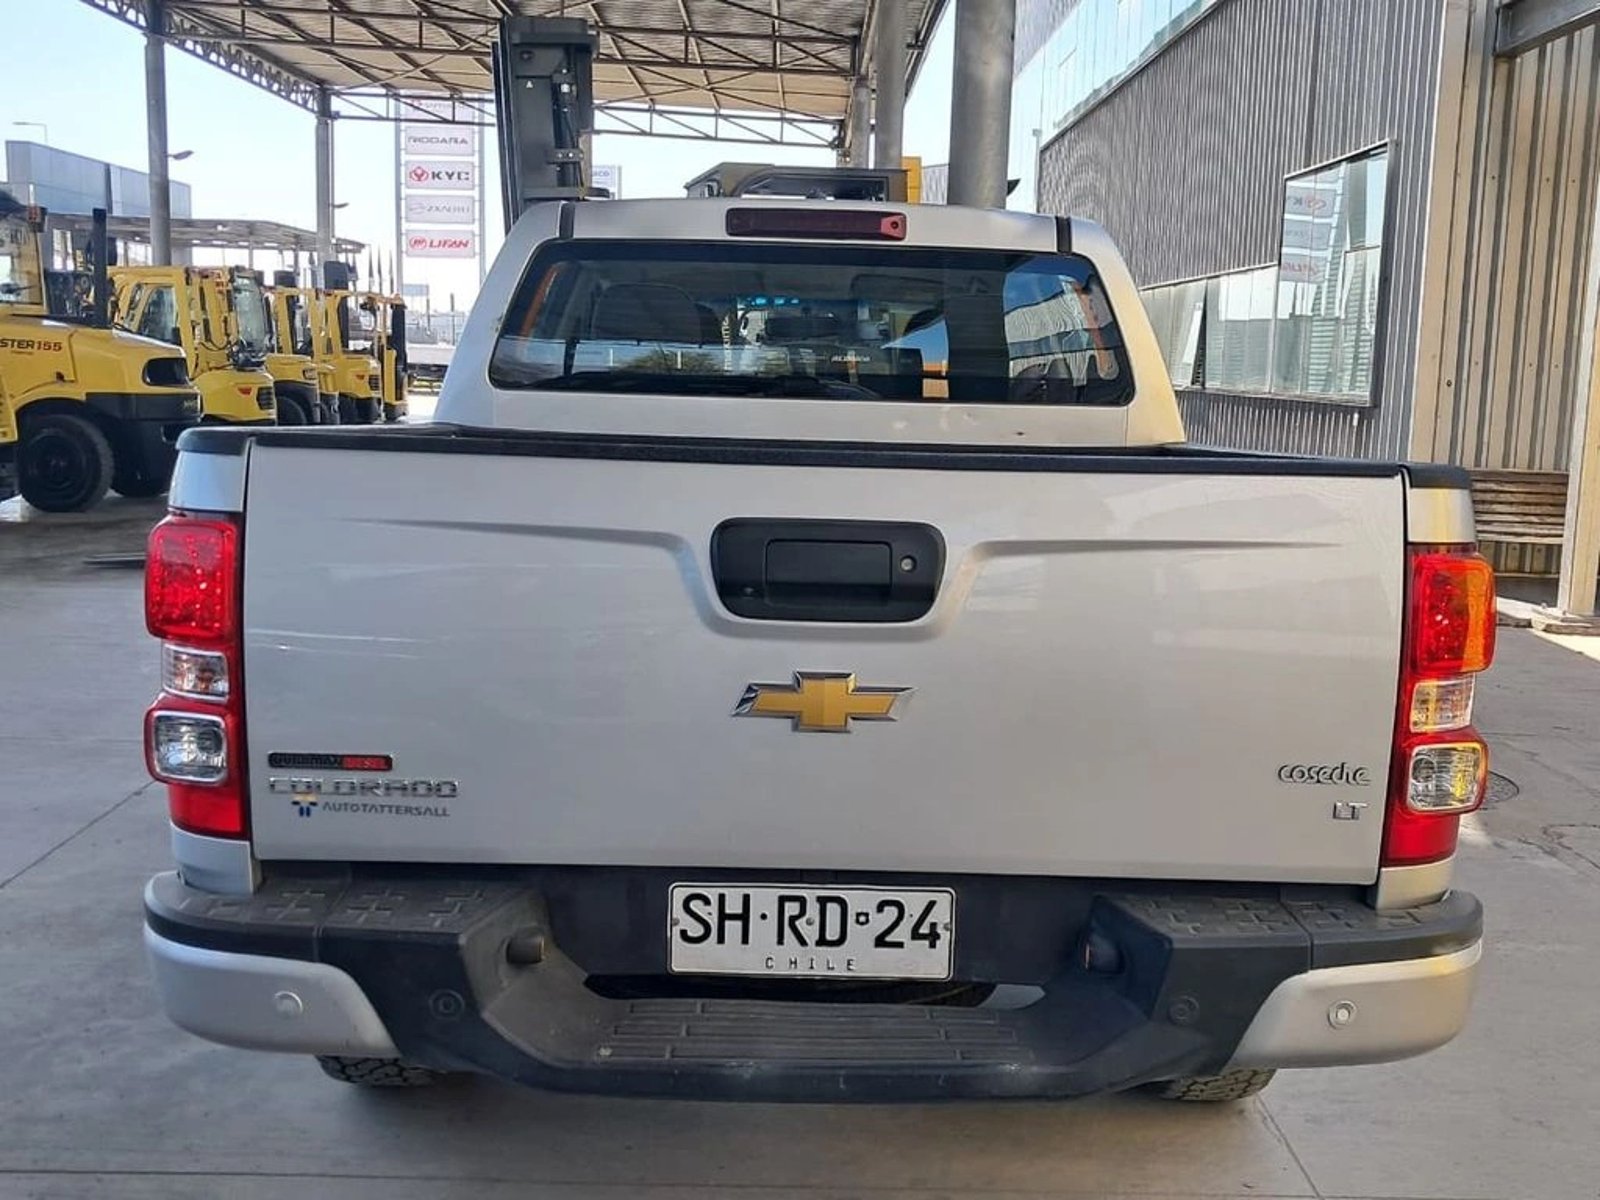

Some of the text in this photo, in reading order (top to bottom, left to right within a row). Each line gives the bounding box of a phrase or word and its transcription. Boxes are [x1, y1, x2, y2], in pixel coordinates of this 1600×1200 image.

[429, 238, 469, 248] LIFAN
[37, 340, 62, 352] 155
[269, 777, 460, 798] COLORADO
[322, 801, 451, 818] AUTOTATTERSALL
[1333, 801, 1369, 821] LT
[764, 956, 855, 971] CHILE
